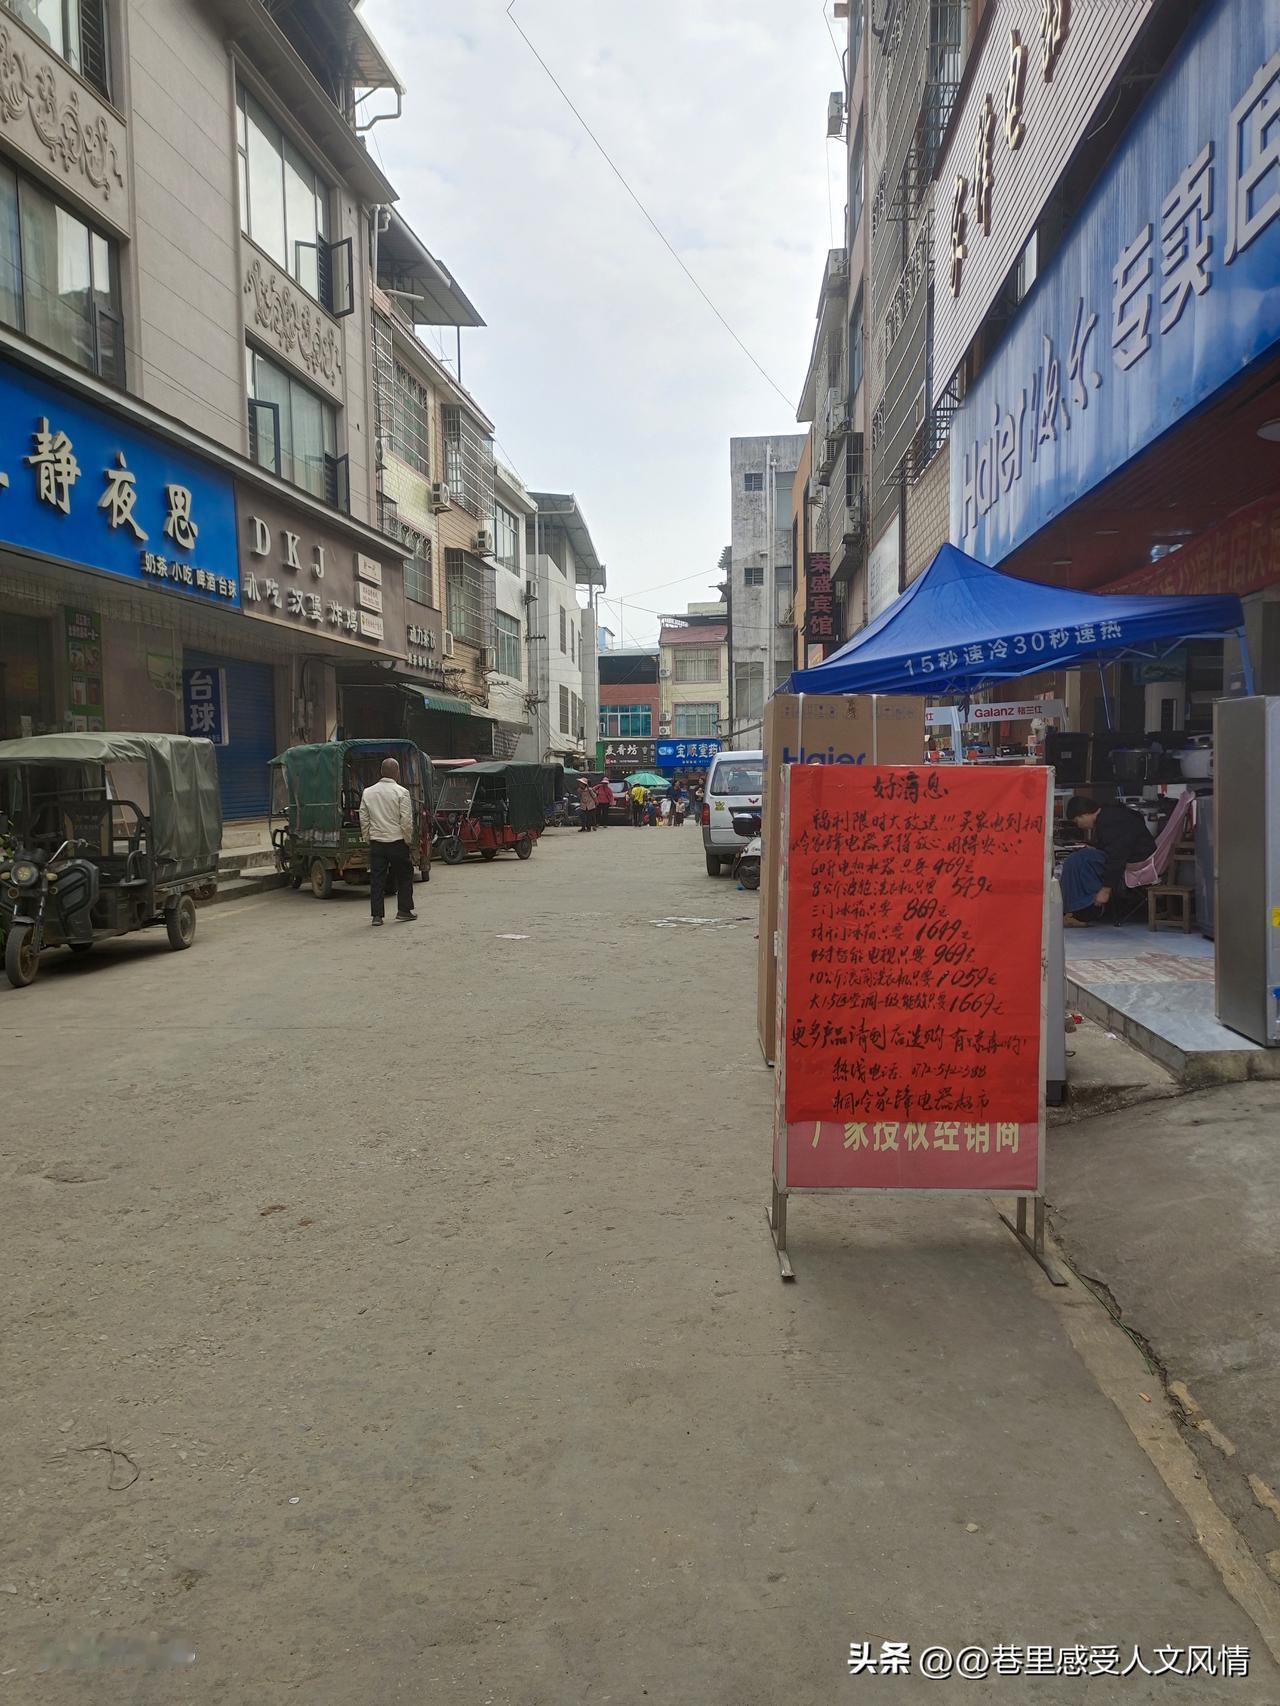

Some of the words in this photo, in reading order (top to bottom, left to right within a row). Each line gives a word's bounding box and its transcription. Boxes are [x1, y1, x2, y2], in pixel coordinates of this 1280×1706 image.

[0, 416, 199, 550] 静夜思
[963, 389, 1027, 538] Haier
[143, 551, 169, 579] 奶茶
[172, 561, 194, 586] 小吃
[249, 515, 326, 580] DKJ
[288, 587, 324, 624] 汉堡
[905, 620, 1123, 677] 15秒速冷30秒速热
[189, 670, 217, 732] 台球
[975, 706, 1014, 718] Galanz
[873, 770, 949, 804] 好消息
